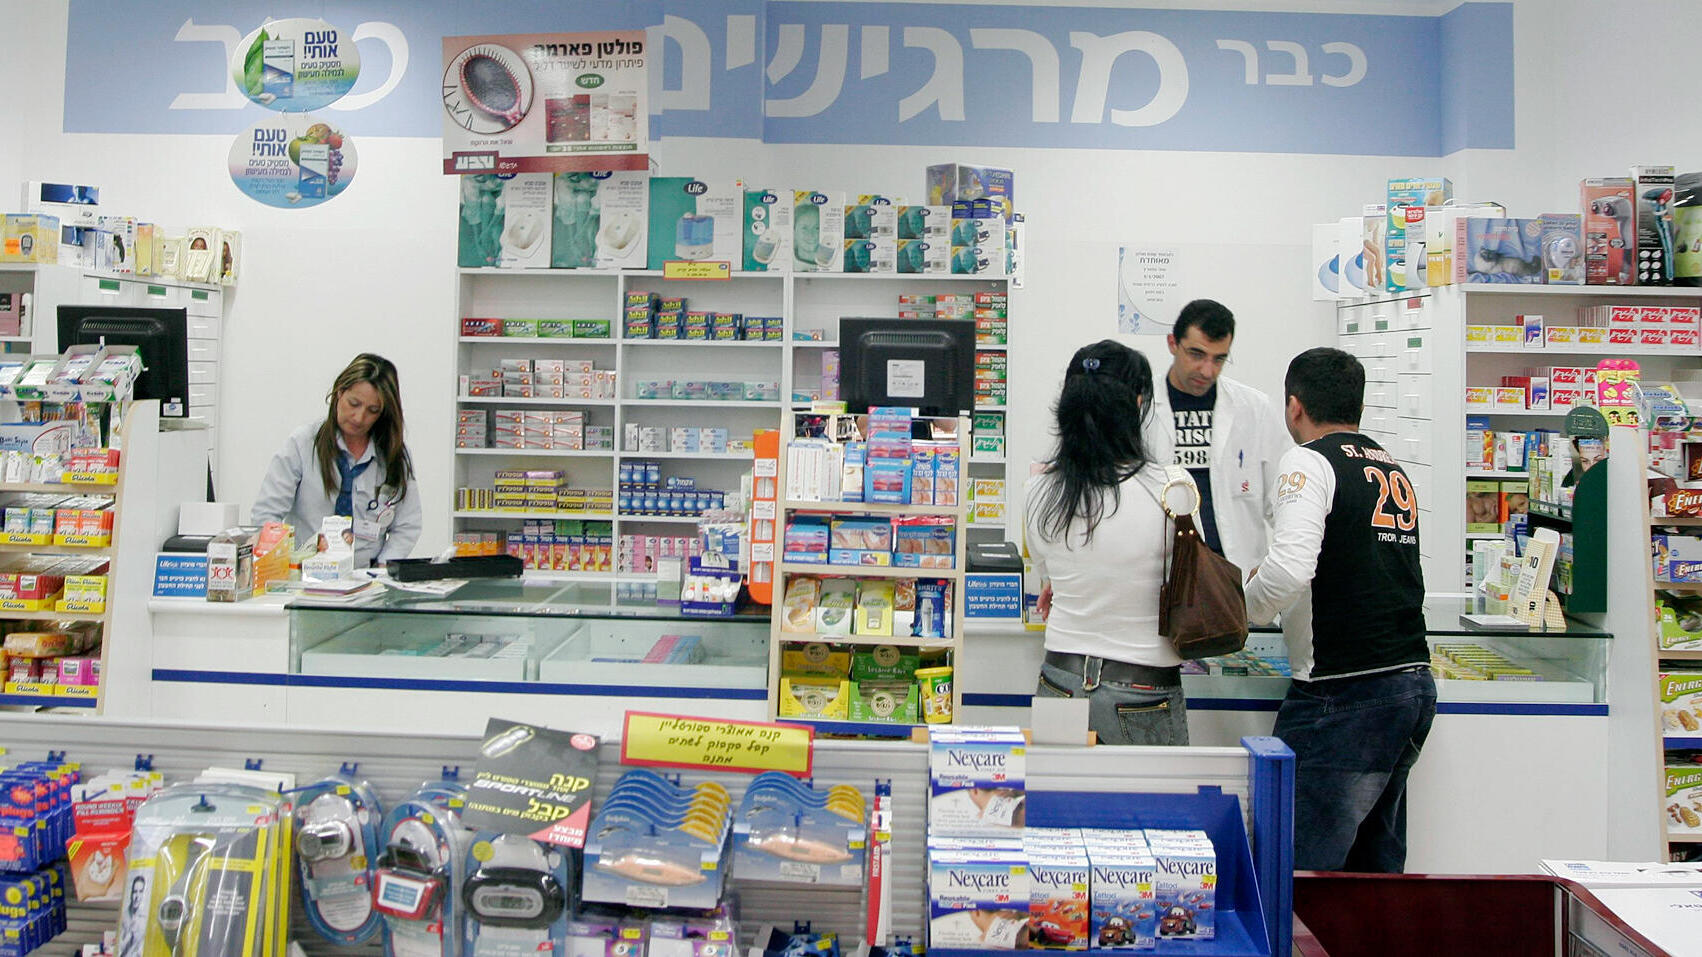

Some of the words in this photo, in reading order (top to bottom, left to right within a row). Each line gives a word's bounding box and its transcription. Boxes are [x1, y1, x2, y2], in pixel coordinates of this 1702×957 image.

[304, 30, 337, 45] טעם
[304, 45, 338, 59] אותי!
[597, 38, 643, 59] פולטן
[589, 60, 613, 70] מדעי
[616, 59, 644, 71] פיתרון
[645, 14, 1190, 127] מרגישים
[1217, 39, 1368, 87] כבר
[580, 77, 600, 85] חדש
[254, 128, 287, 142] טעם
[252, 142, 287, 156] אותי!
[1278, 471, 1307, 497] 29
[1363, 466, 1417, 531] 29
[1399, 533, 1416, 544] JEANS
[1529, 557, 1539, 568] 10
[948, 750, 1006, 772] Nexcare
[550, 773, 589, 792] קנה
[992, 773, 1006, 781] 3M
[473, 779, 577, 803] SPORTLINE
[528, 797, 570, 821] קבל
[553, 824, 584, 836] מבצע
[1155, 858, 1214, 879] Nexcare
[949, 870, 1009, 893] Nexcare
[1030, 867, 1085, 889] Nexcare
[1094, 867, 1153, 888] Nexcare
[995, 894, 1009, 902] 3M
[1072, 892, 1086, 900] 3M
